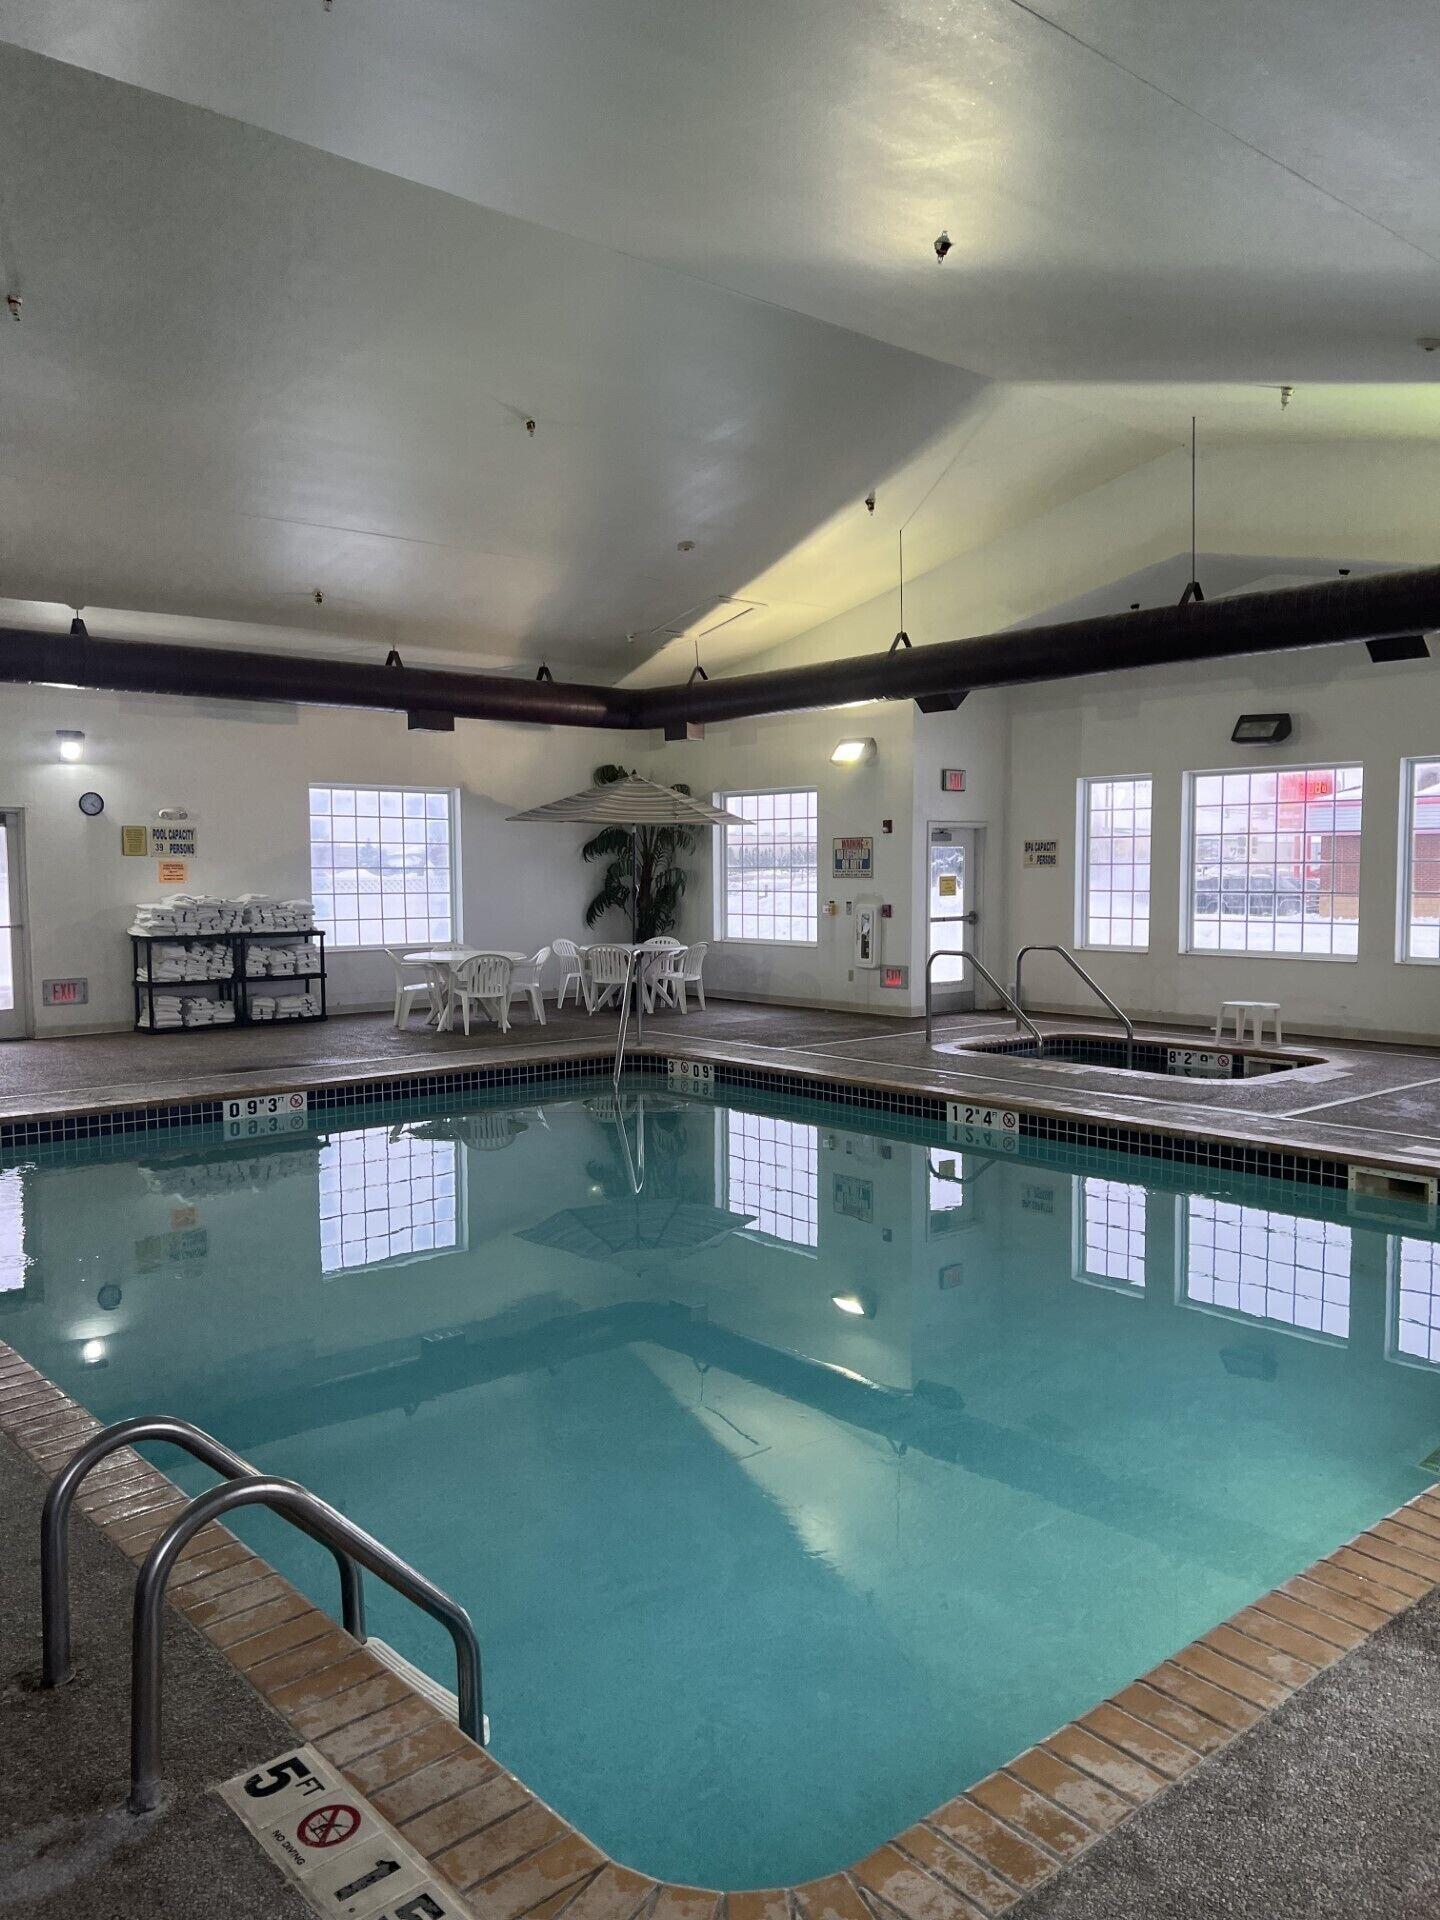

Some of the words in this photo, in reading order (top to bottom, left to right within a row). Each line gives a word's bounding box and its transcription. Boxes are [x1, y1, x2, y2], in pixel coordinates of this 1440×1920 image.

[152, 828, 167, 840] POOL
[168, 829, 194, 841] CAPACITY
[155, 843, 164, 852] 39
[169, 843, 195, 854] PERSONS
[1025, 842, 1034, 852] SPA
[1035, 841, 1056, 851] CAPACITY
[1037, 854, 1056, 865] PERSONS
[52, 983, 78, 1001] EXIT
[243, 1757, 311, 1798] 5
[295, 1777, 326, 1796] FT
[272, 1829, 287, 1844] NO
[281, 1842, 306, 1866] DIVING
